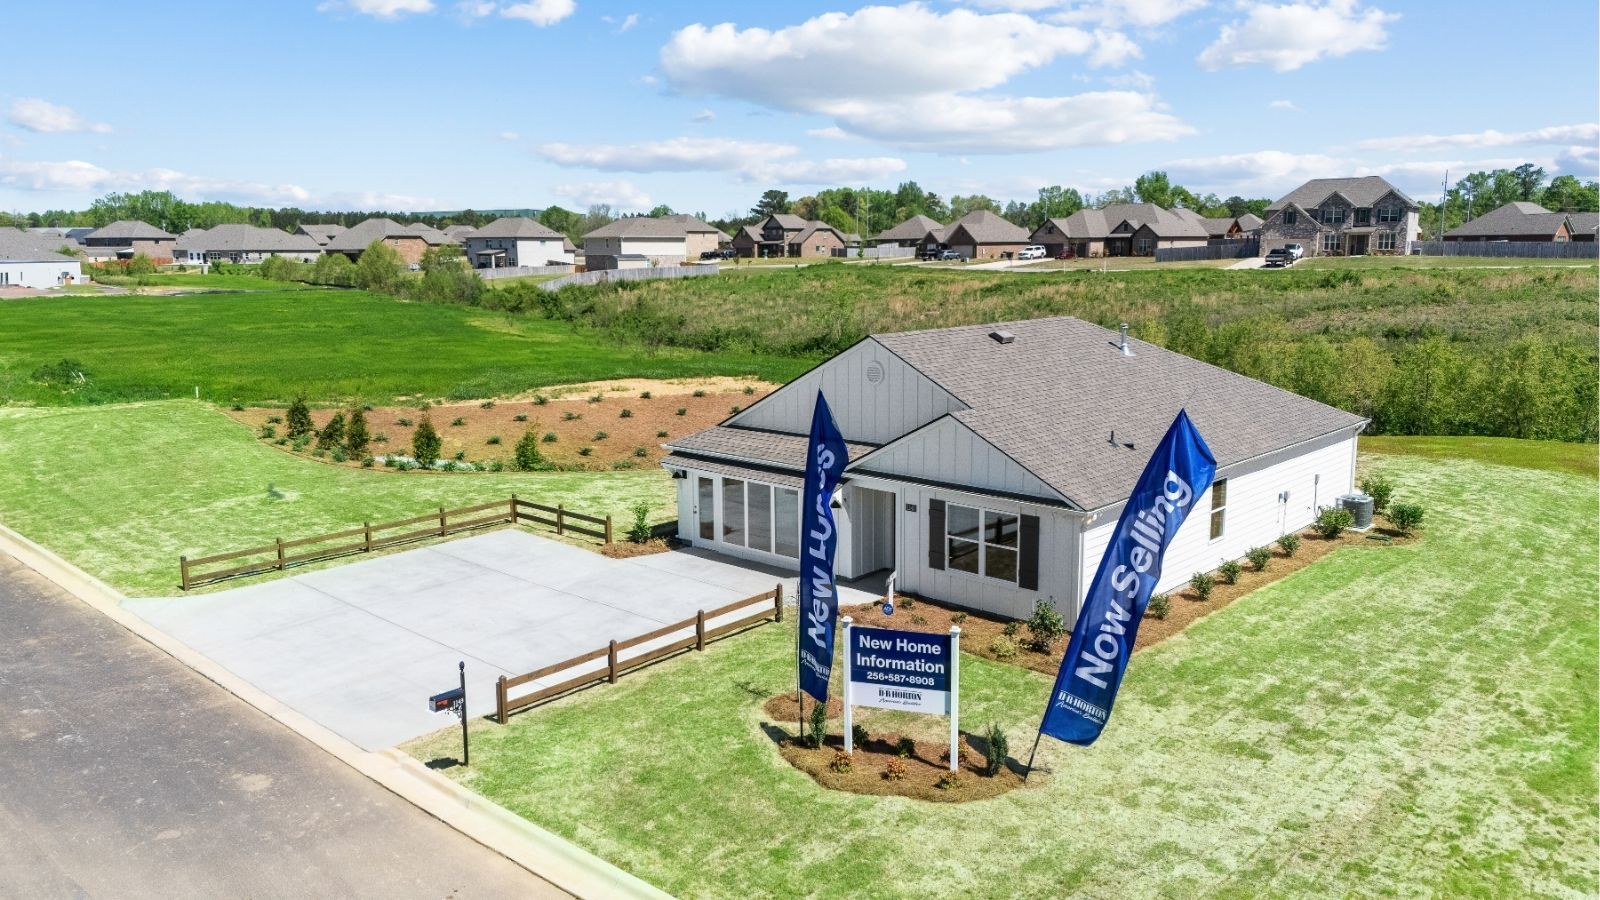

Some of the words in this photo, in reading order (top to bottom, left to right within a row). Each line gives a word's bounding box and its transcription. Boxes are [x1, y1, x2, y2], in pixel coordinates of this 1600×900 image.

[1074, 599, 1133, 689] Now
[1111, 470, 1193, 599] Selling
[808, 566, 833, 649] New
[856, 652, 945, 674] Information
[859, 634, 892, 650] New
[896, 638, 941, 655] Home
